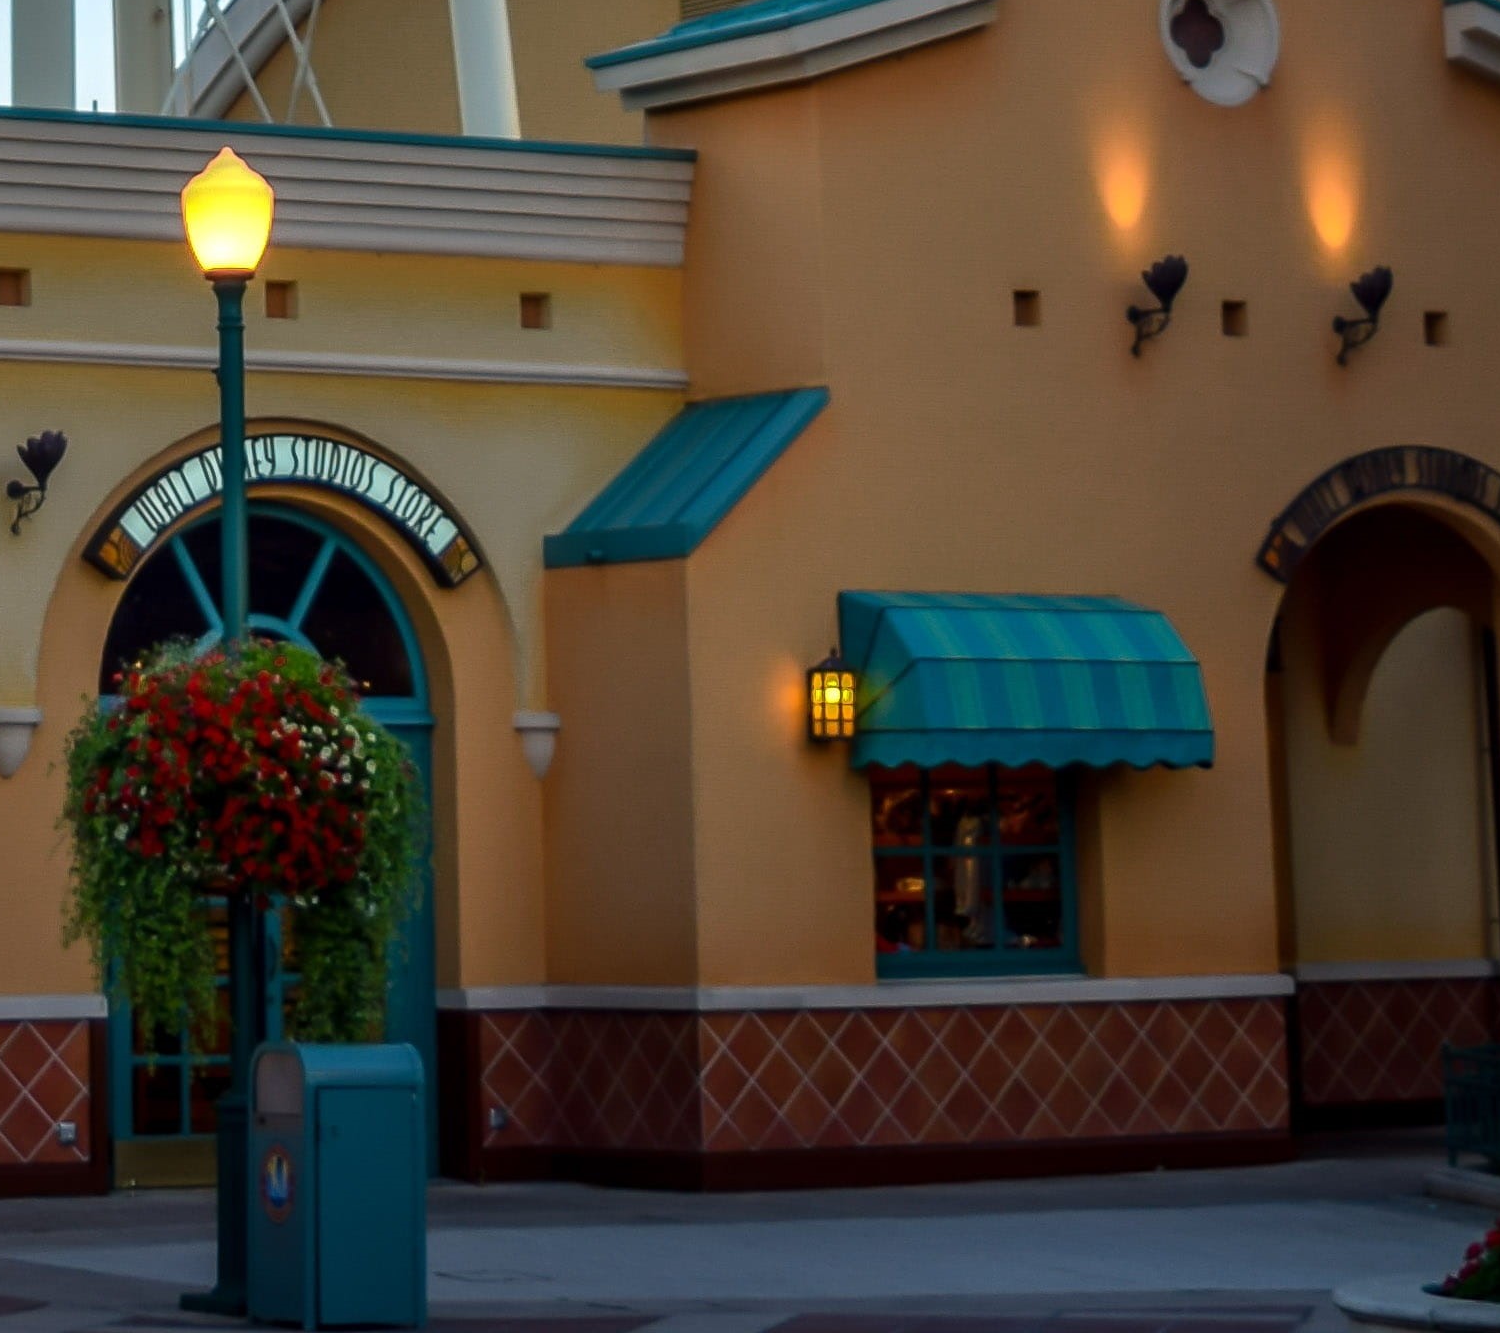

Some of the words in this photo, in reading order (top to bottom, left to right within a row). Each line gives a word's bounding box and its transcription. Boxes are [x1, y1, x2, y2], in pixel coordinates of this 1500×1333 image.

[133, 468, 196, 532] WALT
[291, 436, 380, 494] STUDIOS
[383, 473, 444, 541] STORE
